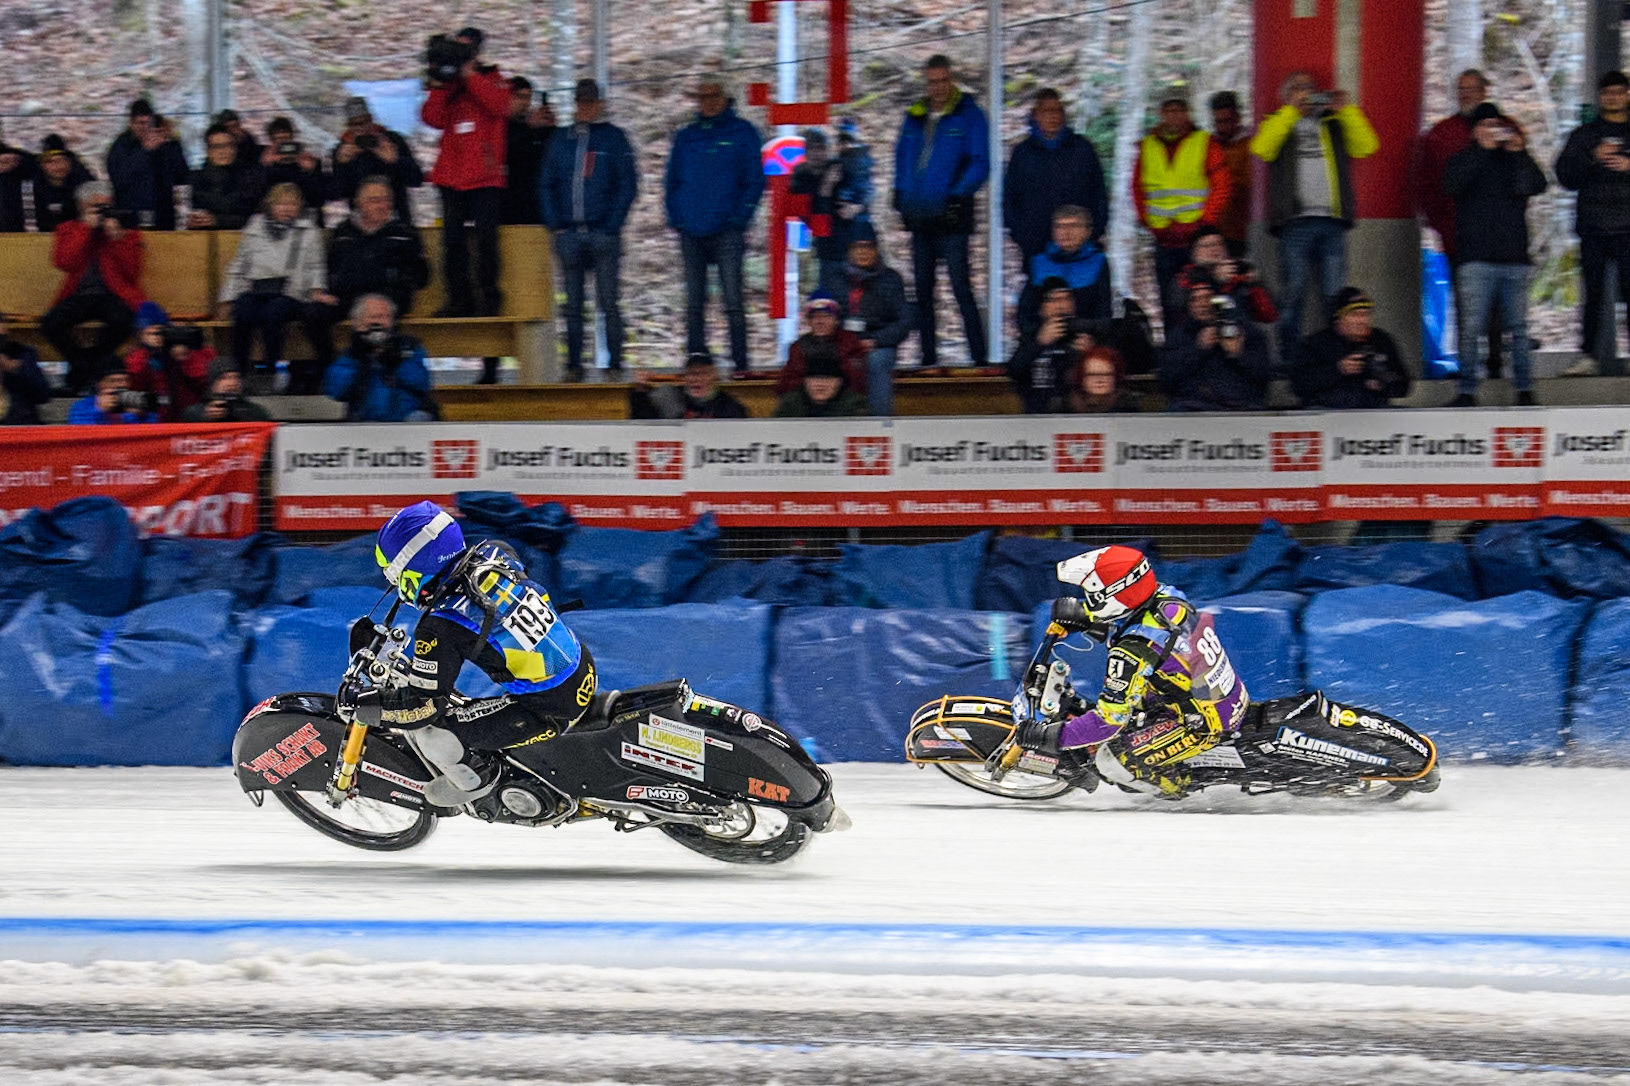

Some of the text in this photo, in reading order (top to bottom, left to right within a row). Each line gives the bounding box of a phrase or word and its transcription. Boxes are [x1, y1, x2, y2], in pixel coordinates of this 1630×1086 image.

[693, 441, 840, 468] Josef Fuchs
[899, 440, 1049, 466] Josef Fuchs
[1115, 437, 1265, 465] Josef Fuchs
[1332, 432, 1488, 460] Josef Fuchs
[1554, 429, 1628, 456] Josef
[283, 444, 350, 472] Josef
[353, 444, 427, 469] Fuchs
[487, 445, 630, 471] Josef Fuchs
[509, 593, 555, 645] 193
[1196, 626, 1222, 667] 88
[272, 748, 312, 779] FRAKT
[305, 739, 328, 758] AB
[1279, 726, 1389, 767] Kunemann
[365, 765, 424, 791] MACHTECH
[748, 777, 791, 803] KAT
[648, 786, 687, 802] MOTO
